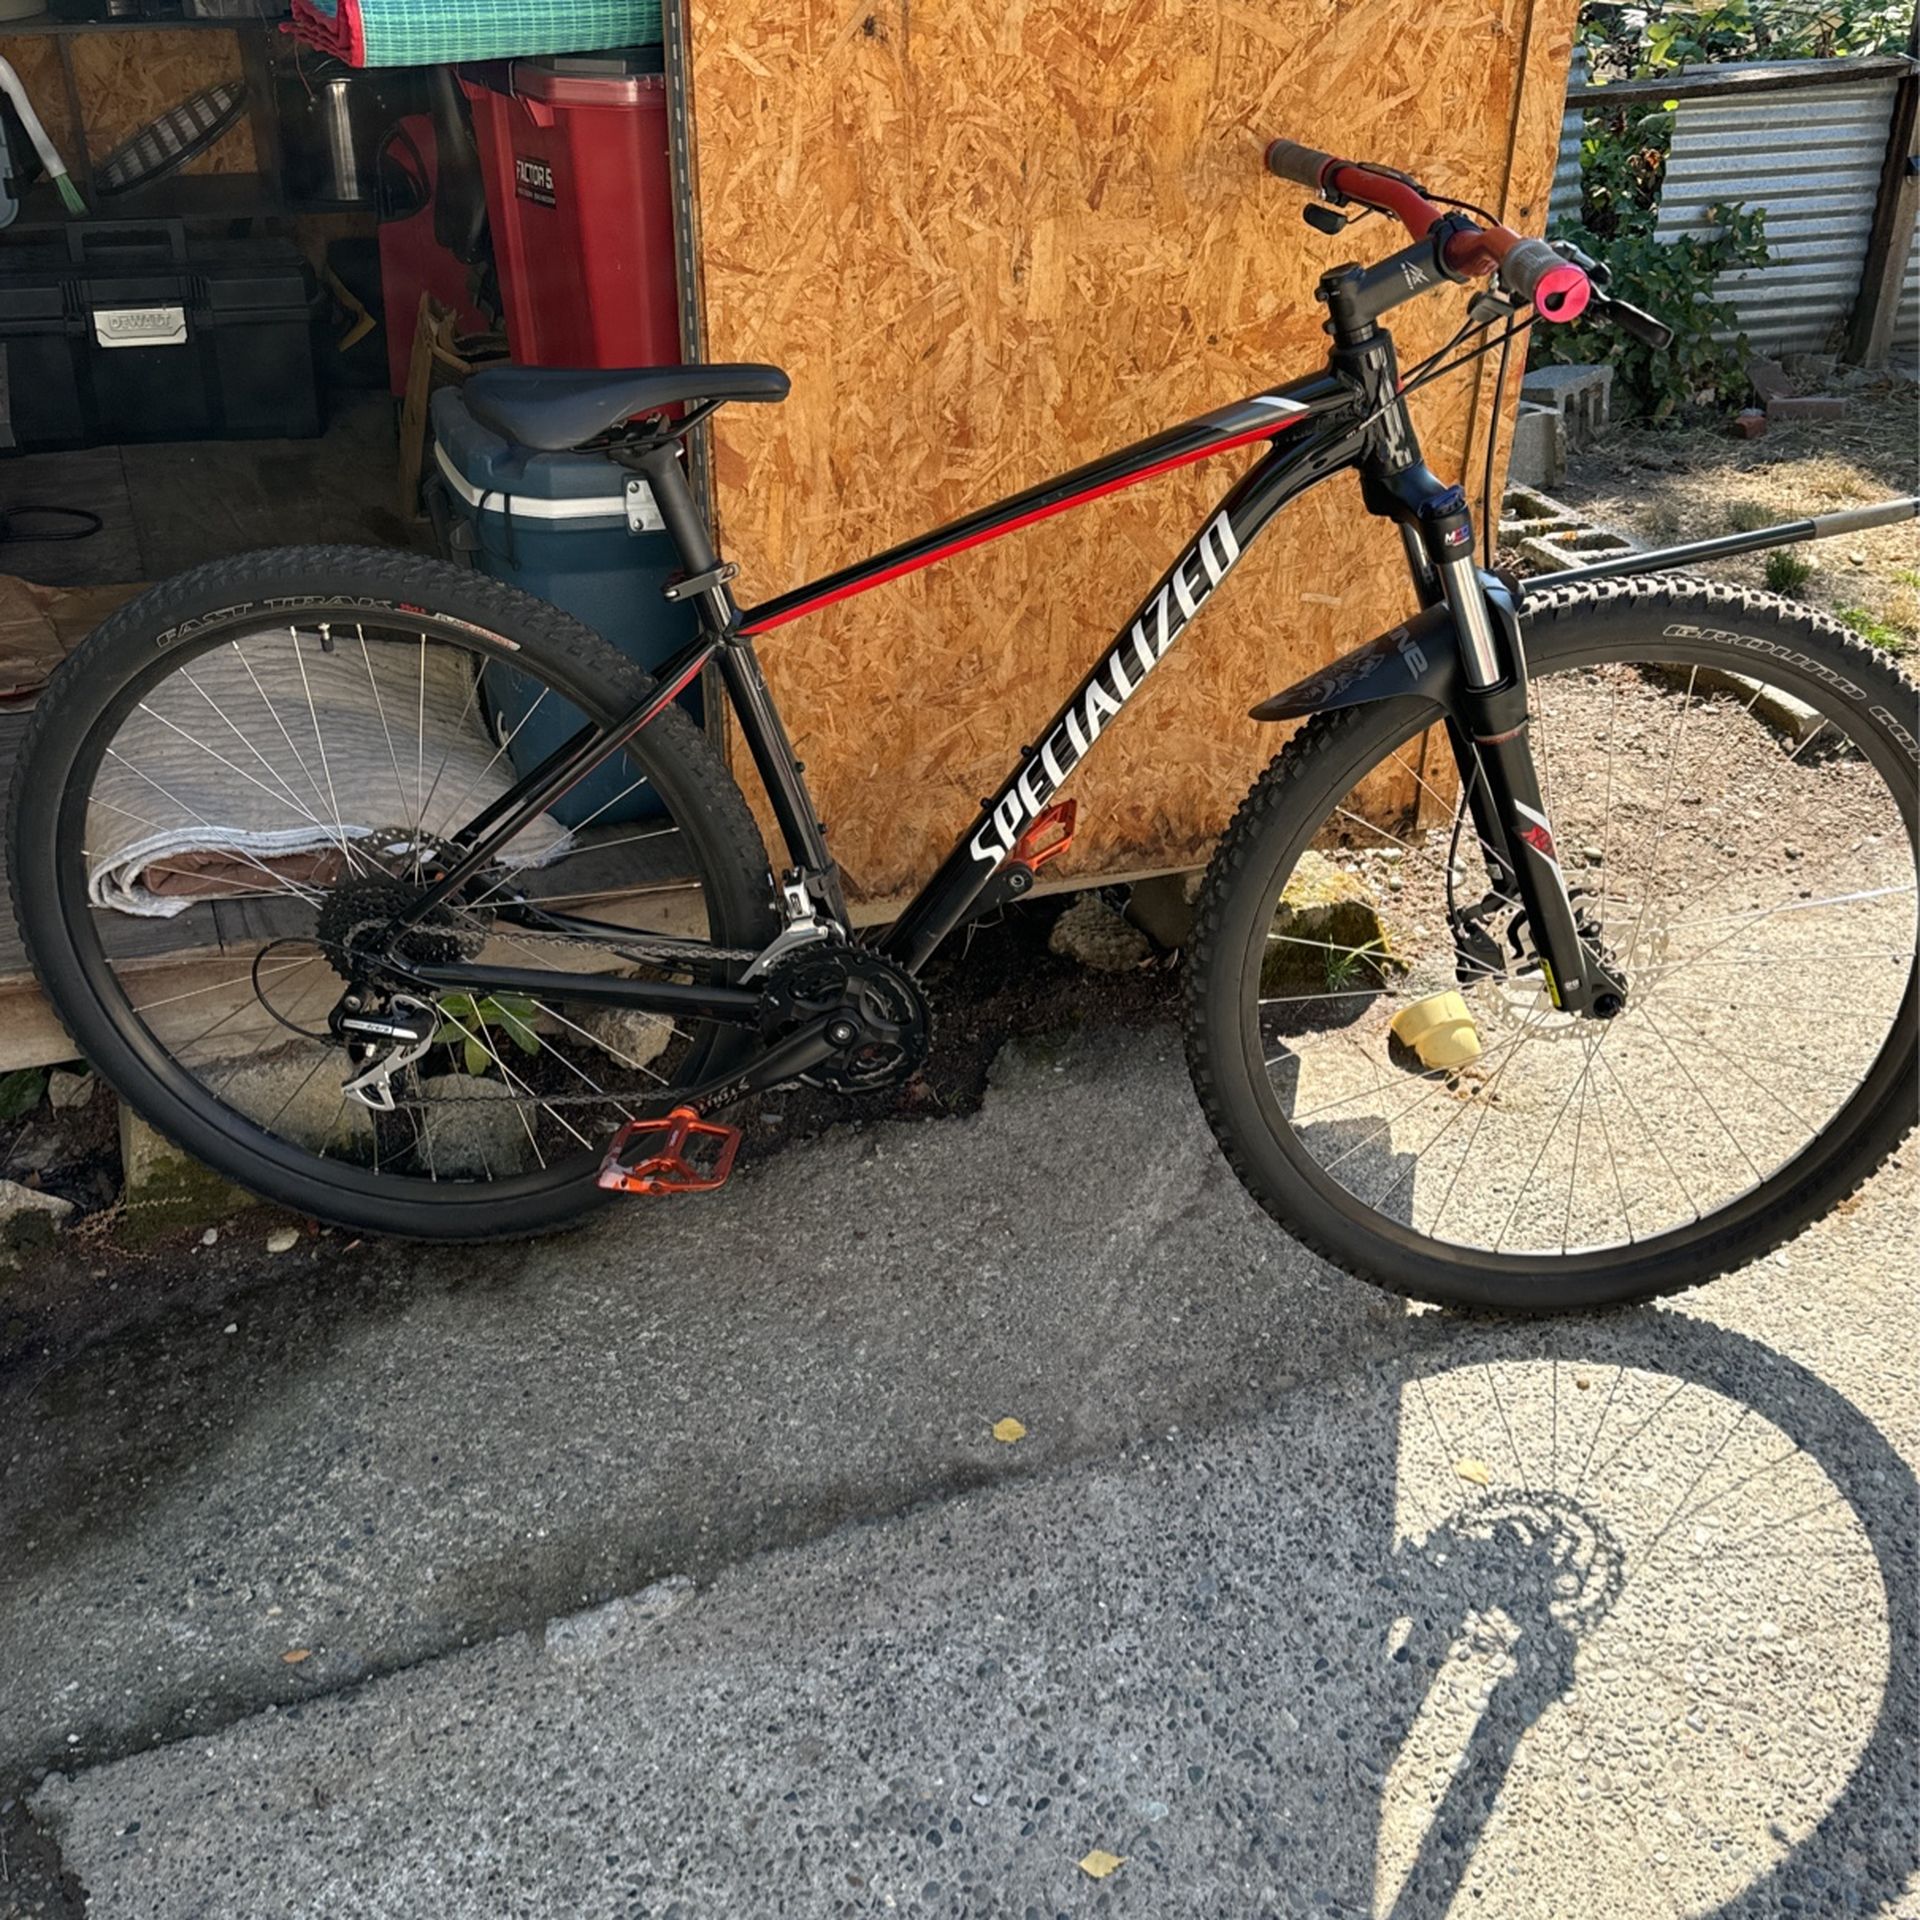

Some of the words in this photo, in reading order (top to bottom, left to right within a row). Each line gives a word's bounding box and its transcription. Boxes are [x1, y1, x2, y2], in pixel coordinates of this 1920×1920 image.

[109, 313, 172, 330] DEWALT
[156, 602, 253, 648] FAST
[970, 509, 1241, 867] SPECIALIZED
[1663, 624, 1867, 700] GROUND
